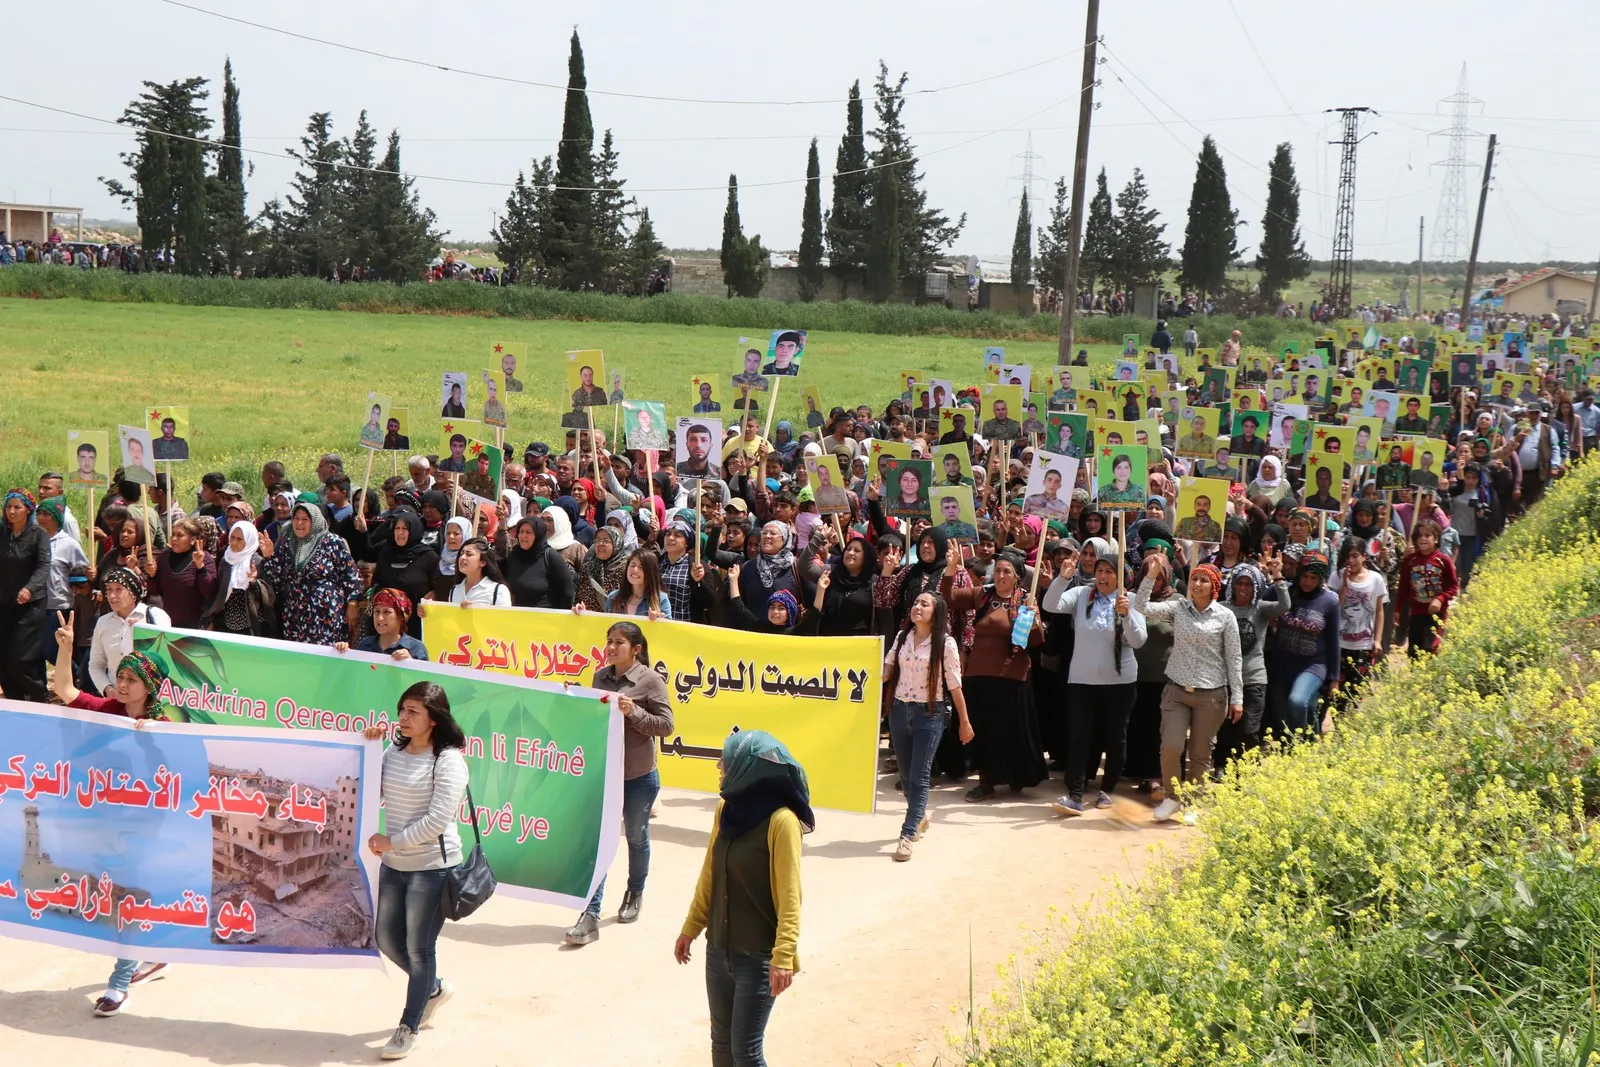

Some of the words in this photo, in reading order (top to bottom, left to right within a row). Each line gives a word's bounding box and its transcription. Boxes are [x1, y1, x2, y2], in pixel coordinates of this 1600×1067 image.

[524, 640, 609, 680] لاحتلال
[675, 656, 755, 703] الدولي
[760, 664, 842, 701] للصمت
[847, 668, 868, 702] لا
[157, 678, 268, 721] Avakirina
[492, 732, 508, 763] li
[514, 737, 586, 776] Efrînê
[76, 765, 182, 811] الأحتلال
[187, 775, 270, 820] مخافر
[276, 783, 327, 833] بناء
[455, 796, 513, 836] ûryê
[516, 814, 550, 844] ye
[117, 889, 209, 932] تقسيم
[215, 900, 257, 939] هو
